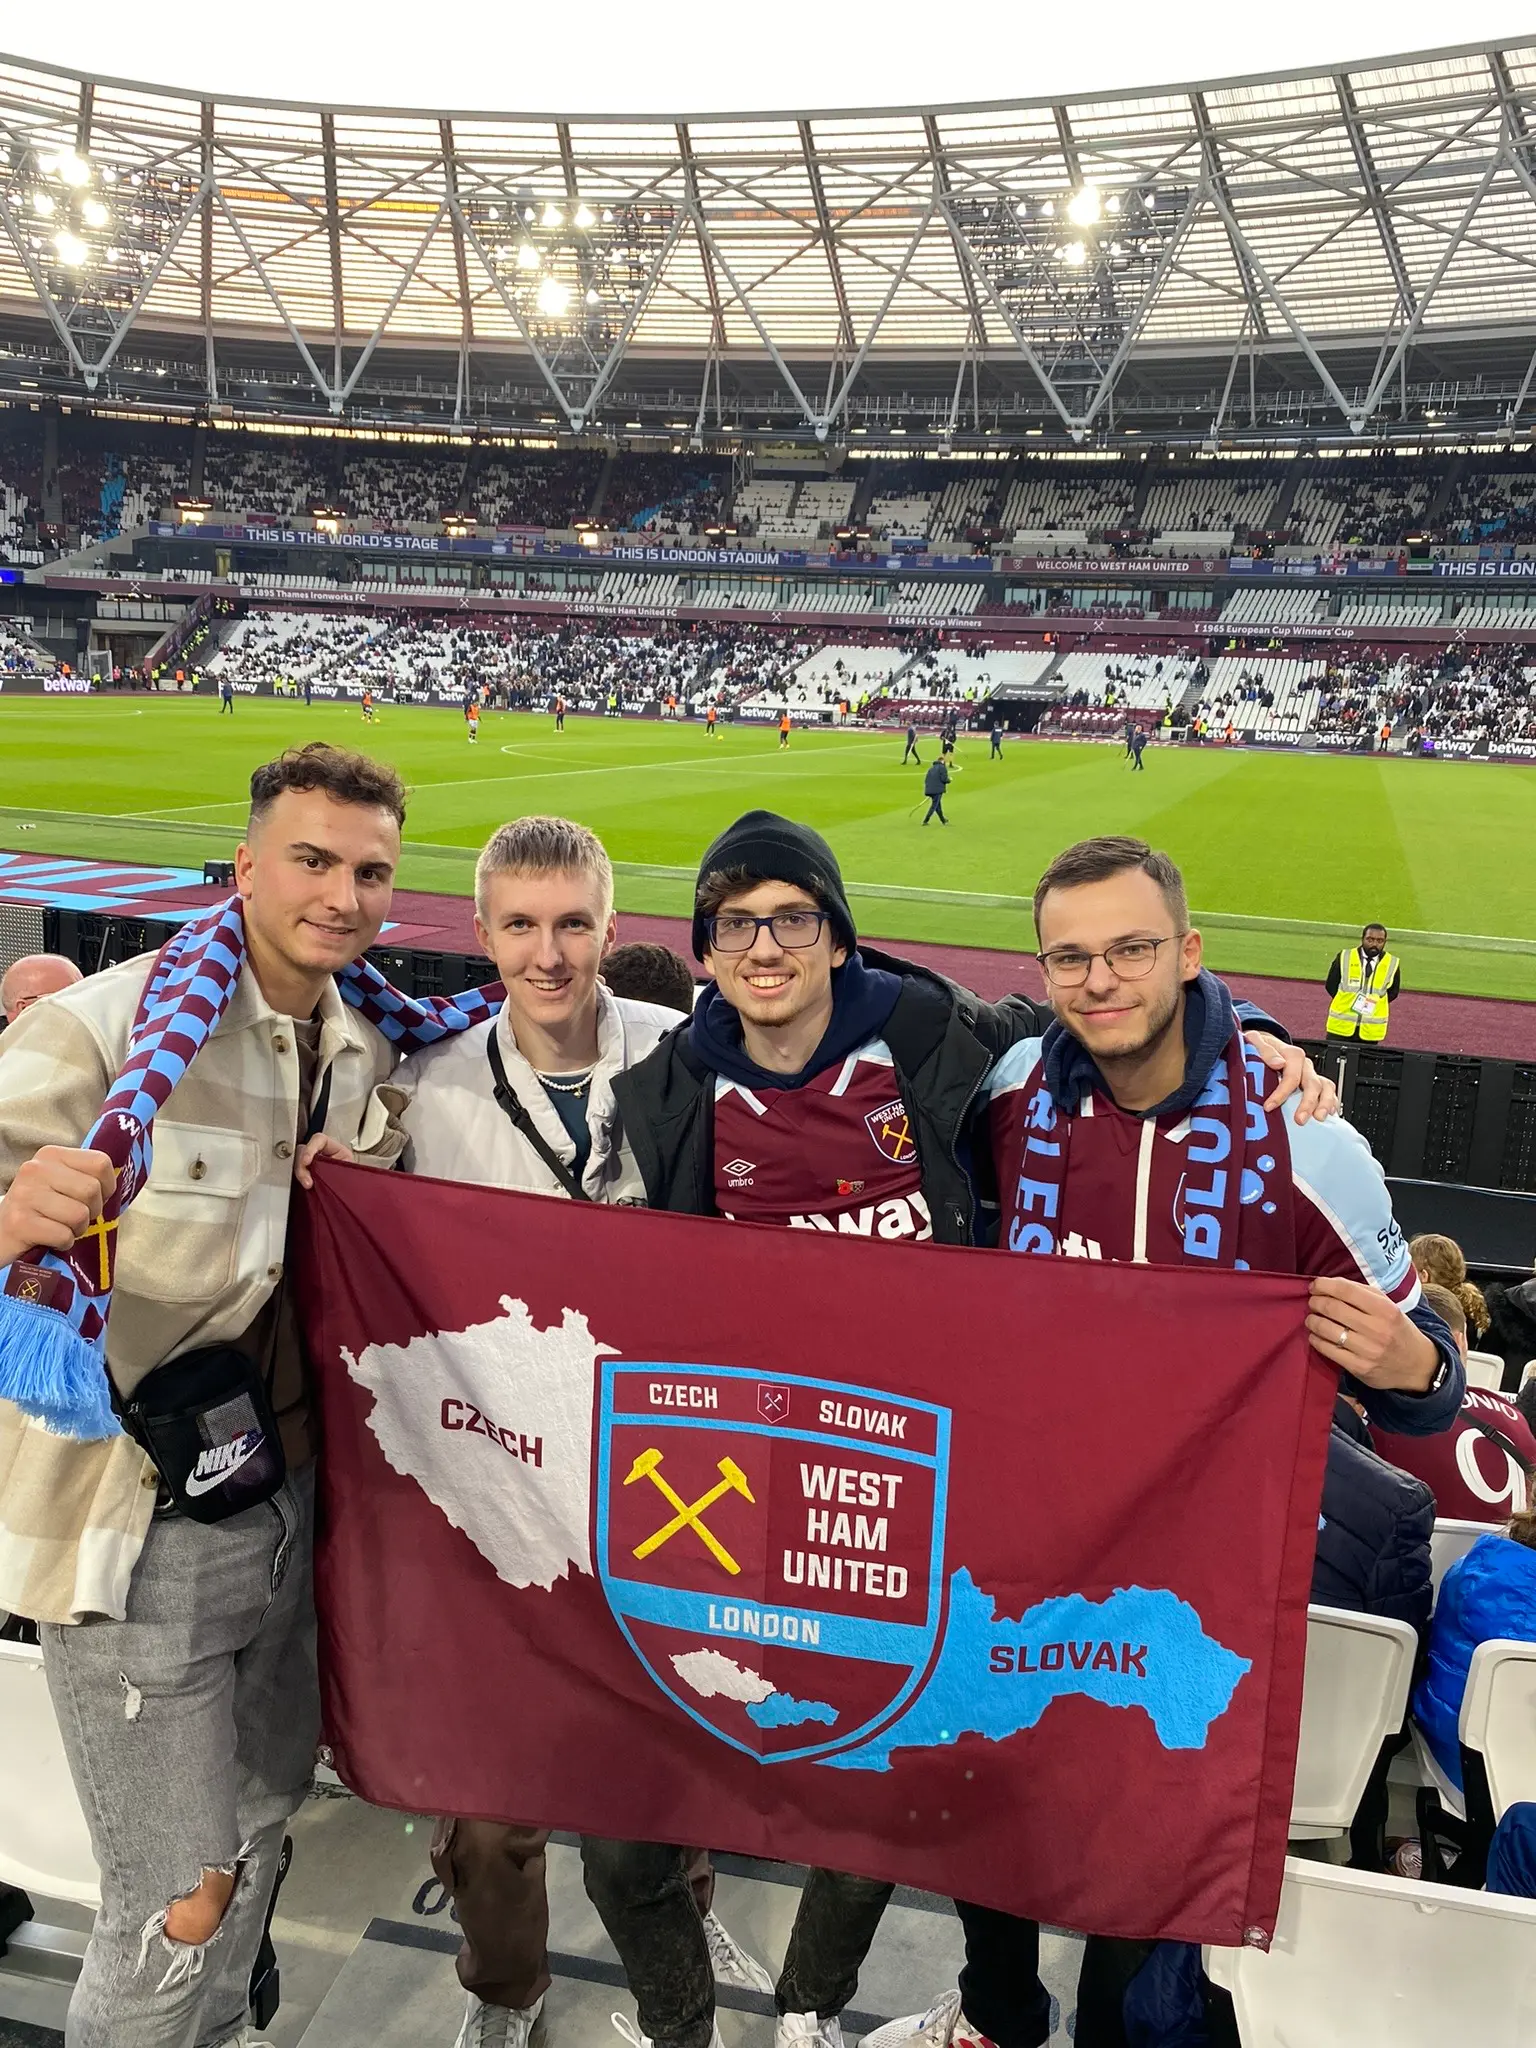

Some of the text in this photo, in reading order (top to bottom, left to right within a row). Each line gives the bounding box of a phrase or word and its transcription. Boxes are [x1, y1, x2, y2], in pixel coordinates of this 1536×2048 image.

[247, 529, 439, 550] THIS IS THE WORLD'S STAGE
[613, 547, 779, 564] THIS IS LONDON STADIUM
[1036, 560, 1190, 571] WELCOME TO WEST HAM UNITED
[1439, 562, 1536, 576] THIS IS LON
[253, 589, 366, 602] 1895 Thames Ironworks FC
[574, 604, 677, 617] 1900 West Ham United FC
[894, 616, 982, 628] 1964 FA Cup Winners
[1202, 624, 1225, 633] 1965
[1226, 624, 1270, 635] European
[1271, 625, 1291, 636] Cup
[1335, 627, 1354, 637] Cup
[43, 678, 91, 693] betway
[740, 706, 778, 720] betway
[787, 708, 819, 720] betwa
[1255, 730, 1302, 745] betway
[871, 1107, 891, 1123] WEST
[881, 1108, 906, 1124] UNITED
[727, 1177, 754, 1188] umbro
[649, 1383, 908, 1440] CZECH SLOVAK
[441, 1398, 543, 1468] CZECH
[195, 1433, 250, 1478] NIKE
[1455, 1428, 1527, 1513] 9
[800, 1463, 903, 1509] WEST
[806, 1508, 888, 1552] HAM
[783, 1549, 909, 1599] UNITED
[708, 1604, 821, 1645] LONDON
[989, 1641, 1148, 1678] SLOVAK
